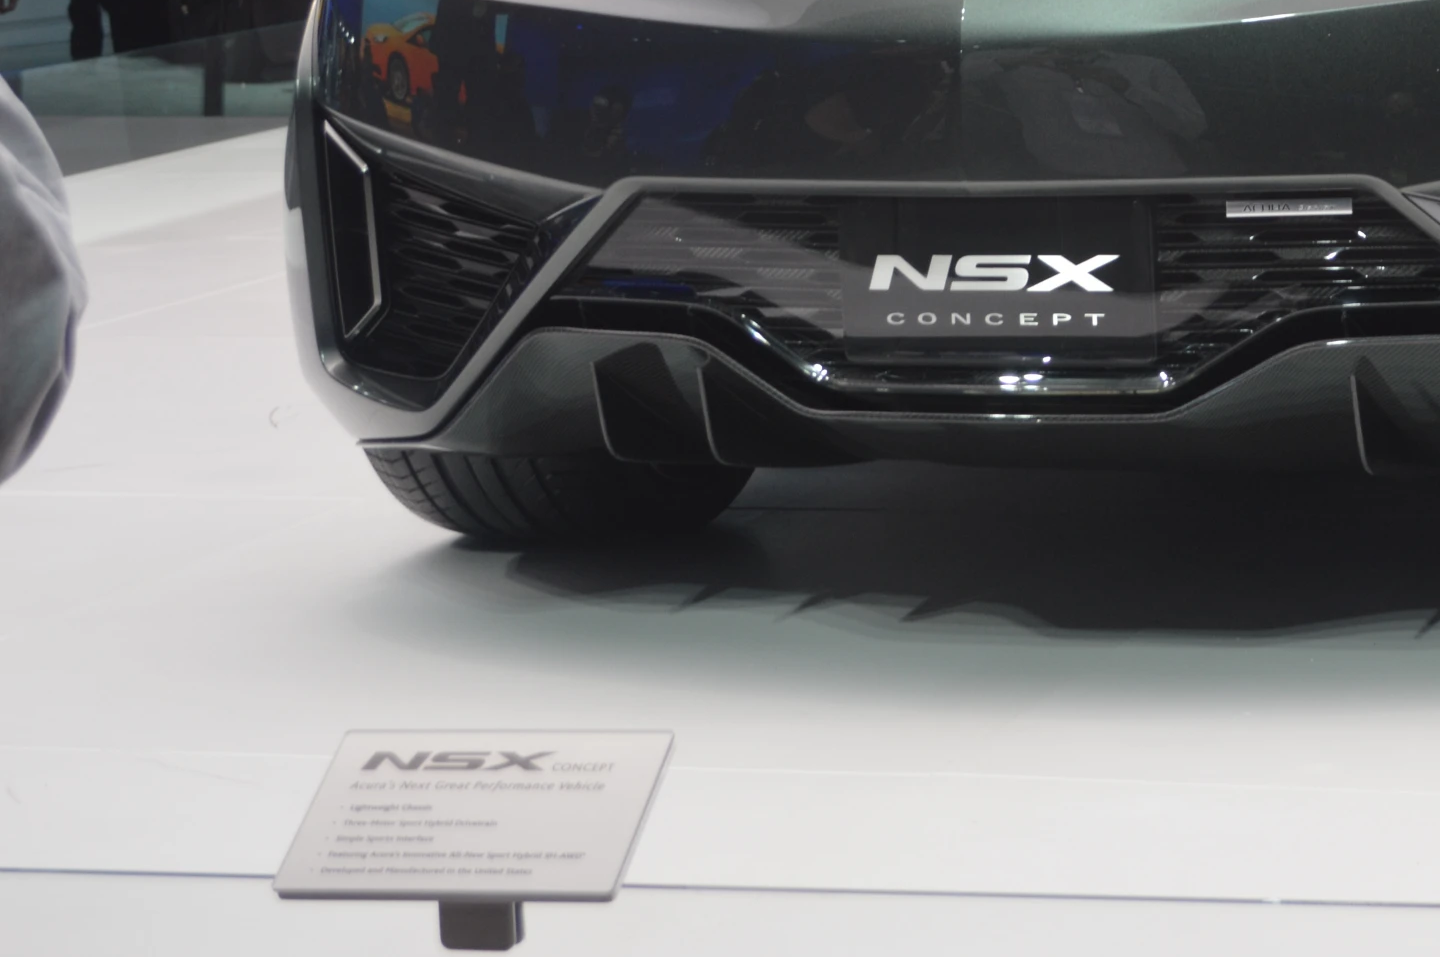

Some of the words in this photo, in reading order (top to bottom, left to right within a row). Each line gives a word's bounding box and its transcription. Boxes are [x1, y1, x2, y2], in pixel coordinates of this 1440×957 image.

[868, 254, 1121, 292] NSX
[886, 311, 1107, 327] CONCEPT
[360, 750, 558, 772] NSX
[551, 761, 616, 772] CONCEPT
[350, 779, 395, 791] Acura's
[399, 780, 431, 791] Next
[434, 780, 471, 791] Great
[473, 780, 556, 793] Performance
[558, 780, 606, 792] Vehicle
